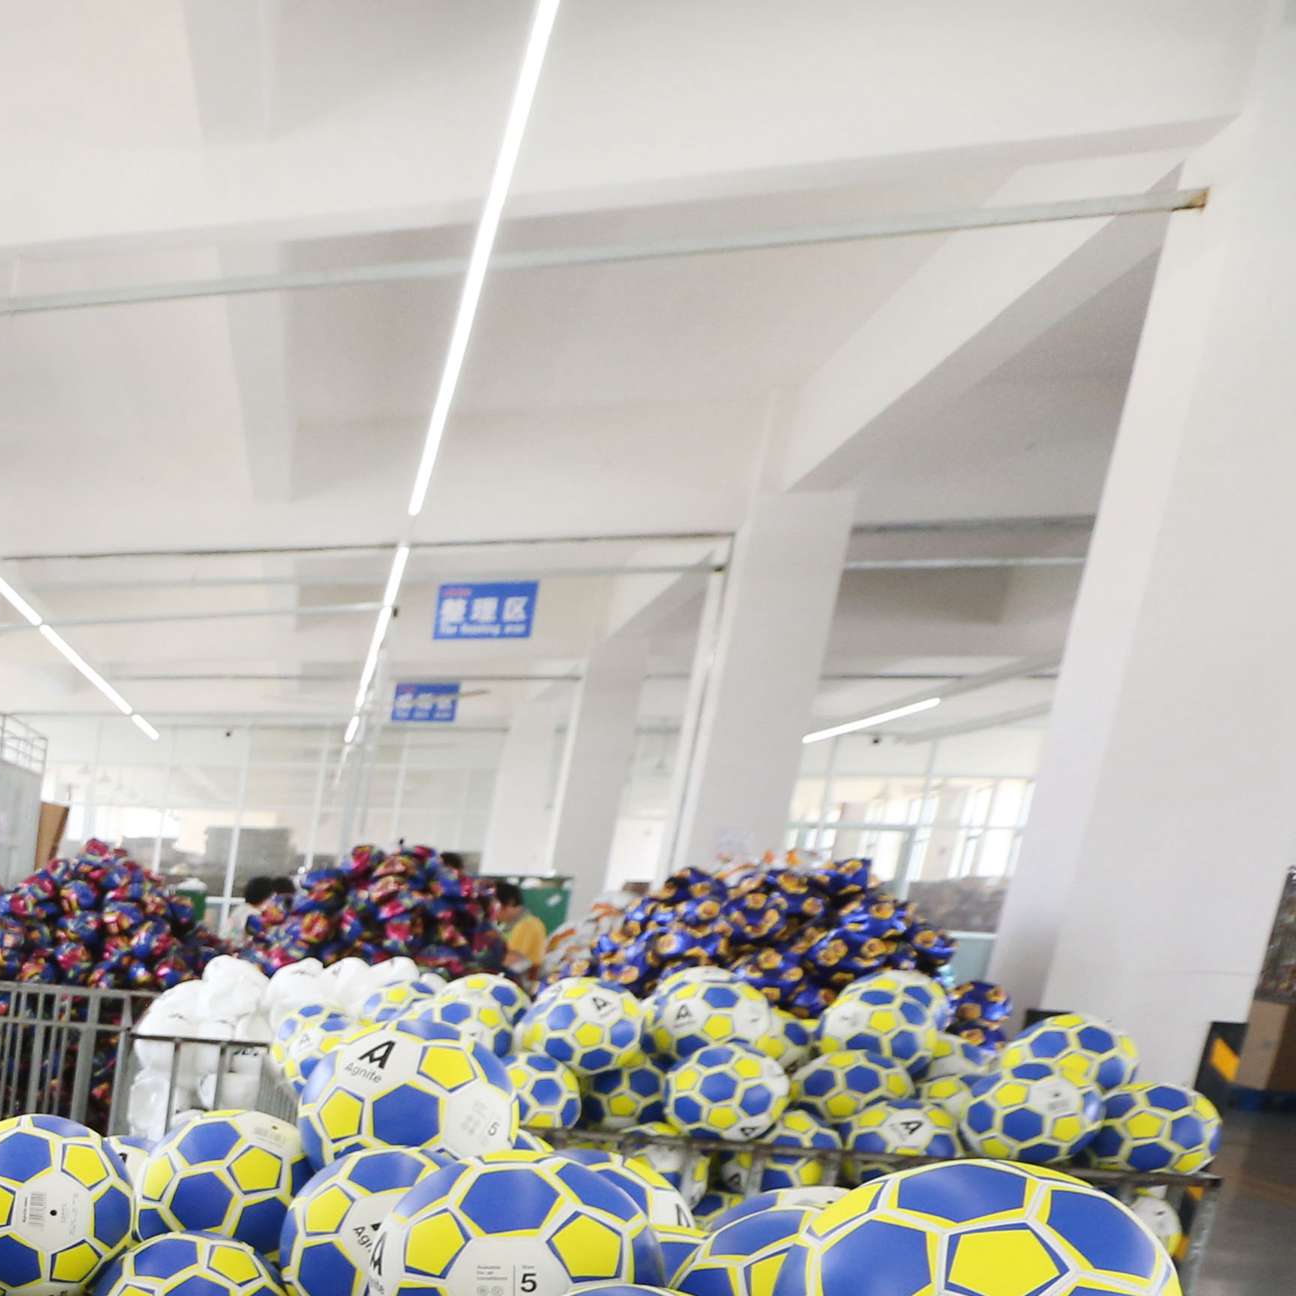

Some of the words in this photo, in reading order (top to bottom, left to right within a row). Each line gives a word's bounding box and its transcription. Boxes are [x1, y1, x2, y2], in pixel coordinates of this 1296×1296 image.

[344, 1061, 382, 1085] Agnite
[487, 1121, 500, 1136] 5
[520, 1273, 537, 1293] 5
